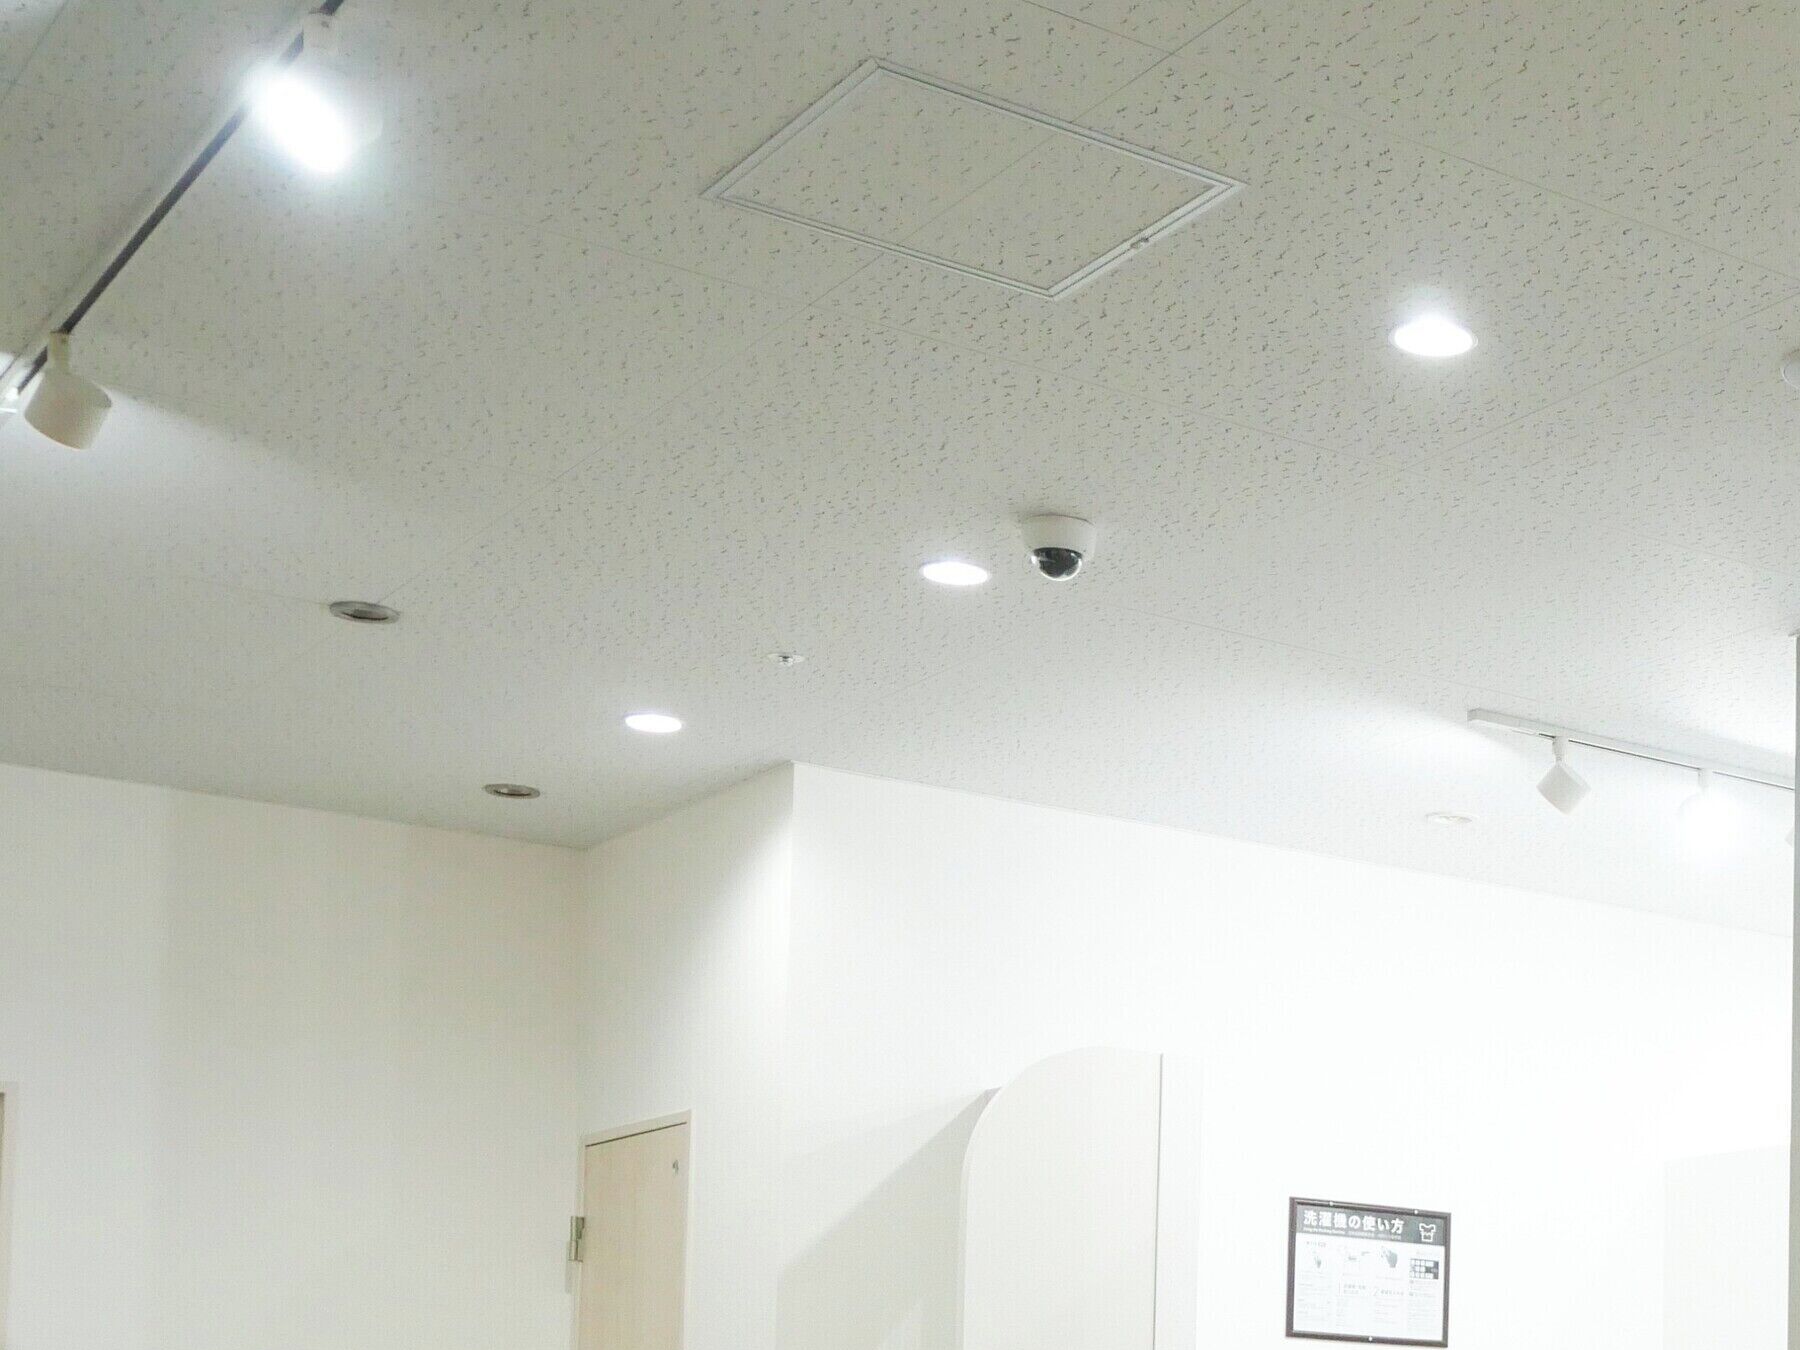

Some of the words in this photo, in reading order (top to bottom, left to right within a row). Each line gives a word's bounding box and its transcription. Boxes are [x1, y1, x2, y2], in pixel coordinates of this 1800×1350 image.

[1303, 1210, 1405, 1234] 洗濯機の使い方
